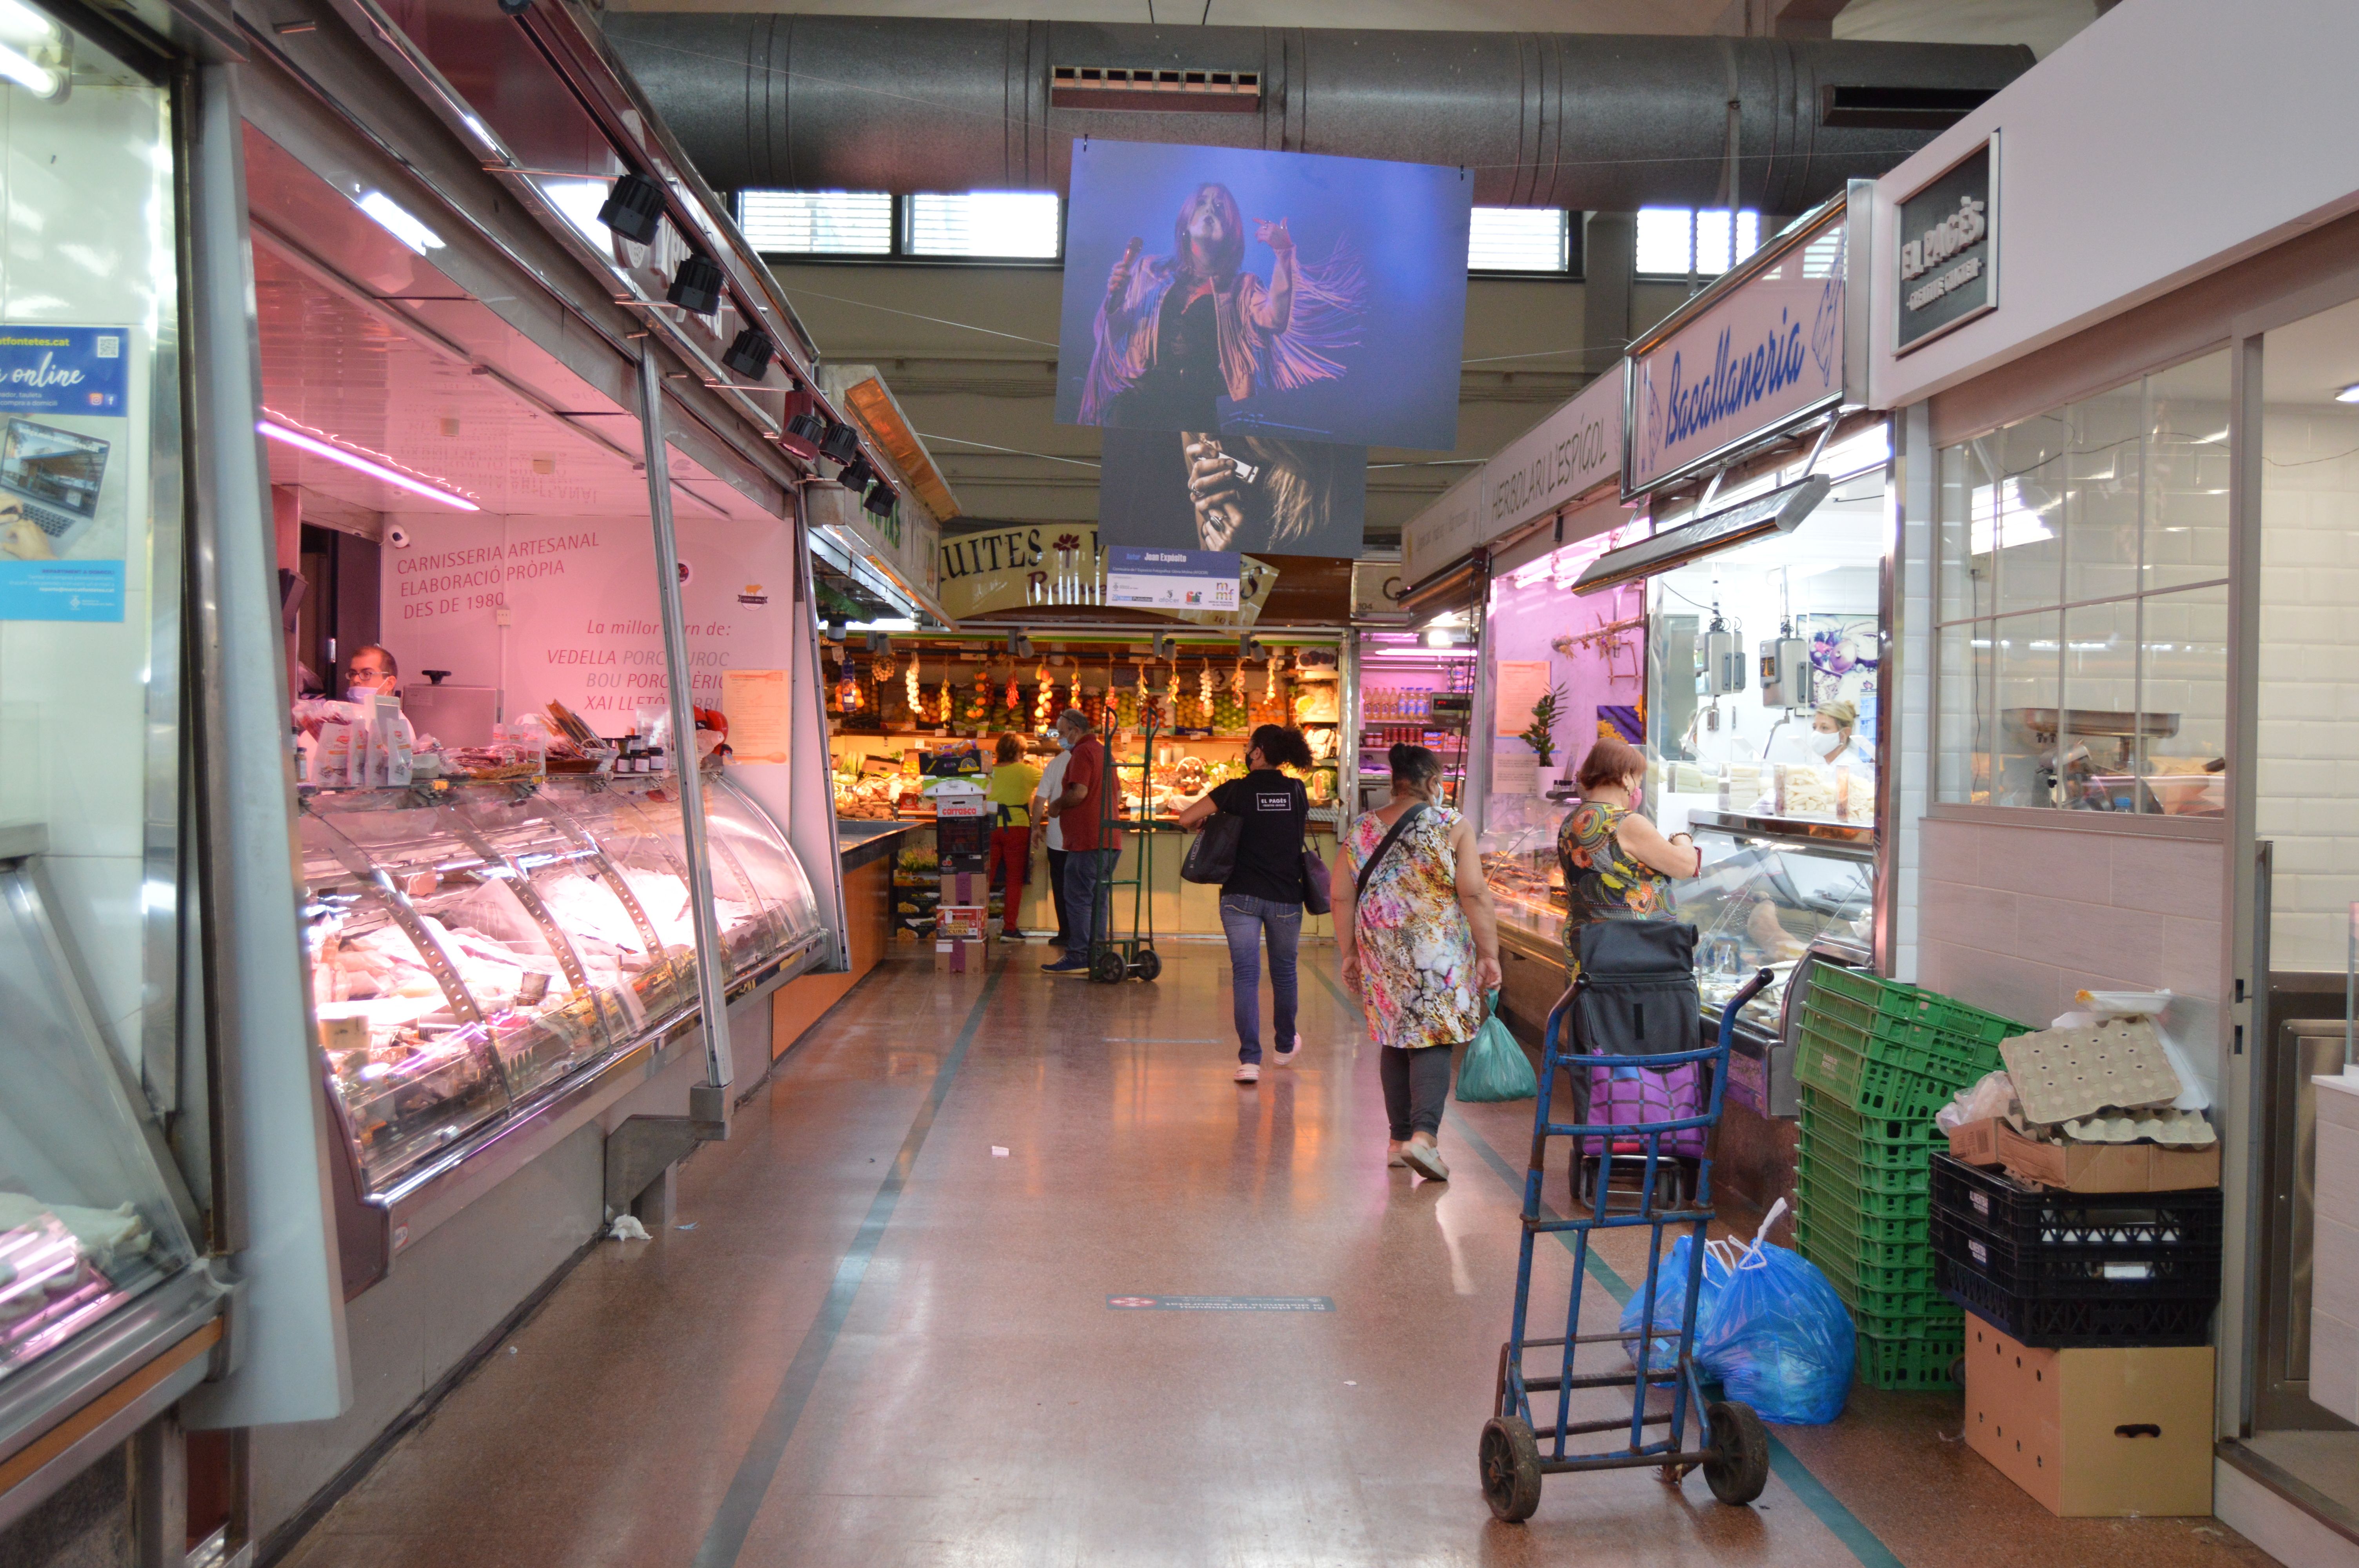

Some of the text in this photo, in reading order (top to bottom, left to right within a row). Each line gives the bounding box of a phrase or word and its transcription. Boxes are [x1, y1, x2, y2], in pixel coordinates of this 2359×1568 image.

[1902, 196, 1985, 280] EL PAGÈS
[12, 352, 86, 388] online
[1665, 306, 1805, 449] Bacallaneria
[1491, 455, 1546, 523] HERBOLARI
[397, 532, 599, 574] CARNISSERIA ARTESANAL
[941, 528, 1043, 582] UITES
[401, 560, 565, 597] ELABORACIÓ PRÒPIA
[404, 592, 504, 619] DES DE 1980
[587, 619, 731, 636] La millor rn de:
[548, 650, 730, 666] VEDELLA PORC UROC
[586, 671, 723, 689] BOU PORC ÈRI
[584, 696, 613, 710] XAI
